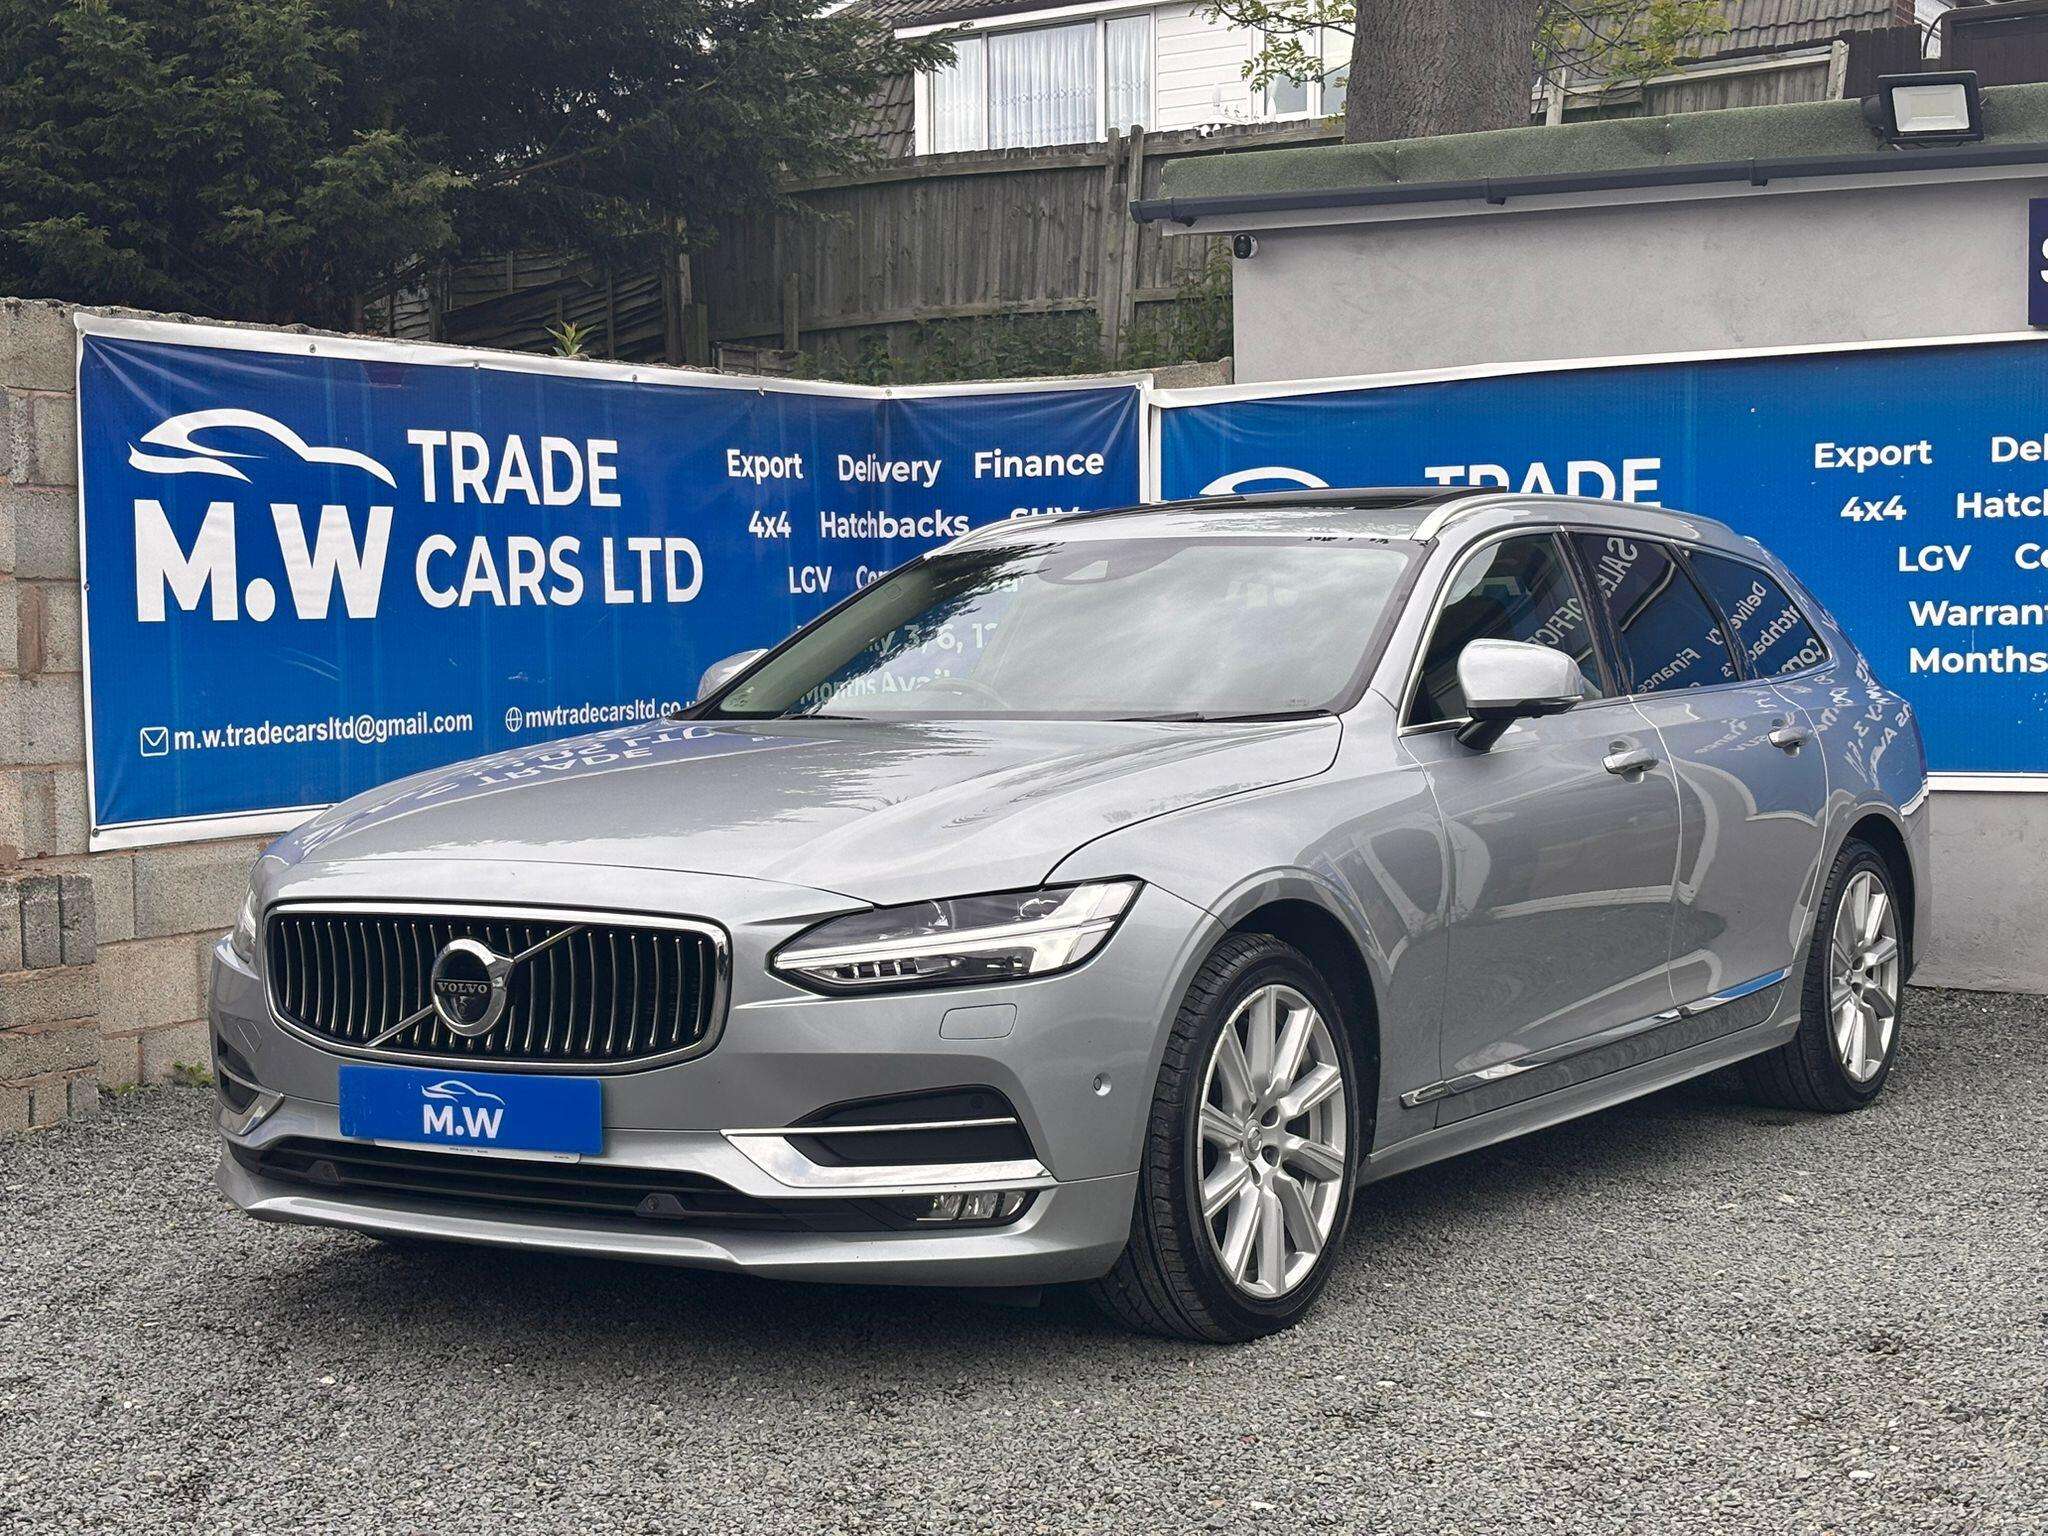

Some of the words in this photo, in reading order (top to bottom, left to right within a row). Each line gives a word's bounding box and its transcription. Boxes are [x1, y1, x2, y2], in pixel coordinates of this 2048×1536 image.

[407, 429, 621, 507] TRADE
[727, 449, 803, 485] Export
[838, 454, 941, 488] Delivery
[974, 448, 1105, 479] Finance
[1814, 440, 1933, 473] Export
[1991, 432, 2048, 463] Del
[748, 510, 791, 538] 4x4
[820, 508, 970, 540] Hatchbacks
[1840, 495, 1907, 522] 4x4
[134, 498, 394, 622] M.W
[415, 535, 584, 608] CARS
[603, 537, 703, 604] LTD
[1898, 545, 1972, 572] LGV
[788, 565, 832, 594] LGV
[1909, 645, 2048, 675] Months
[525, 698, 697, 728] mwtradecarsltd.co
[174, 711, 473, 752] m.w.tradecarsltd@gmail.com
[437, 981, 488, 994] VOLVO
[422, 1103, 504, 1139] M.W
